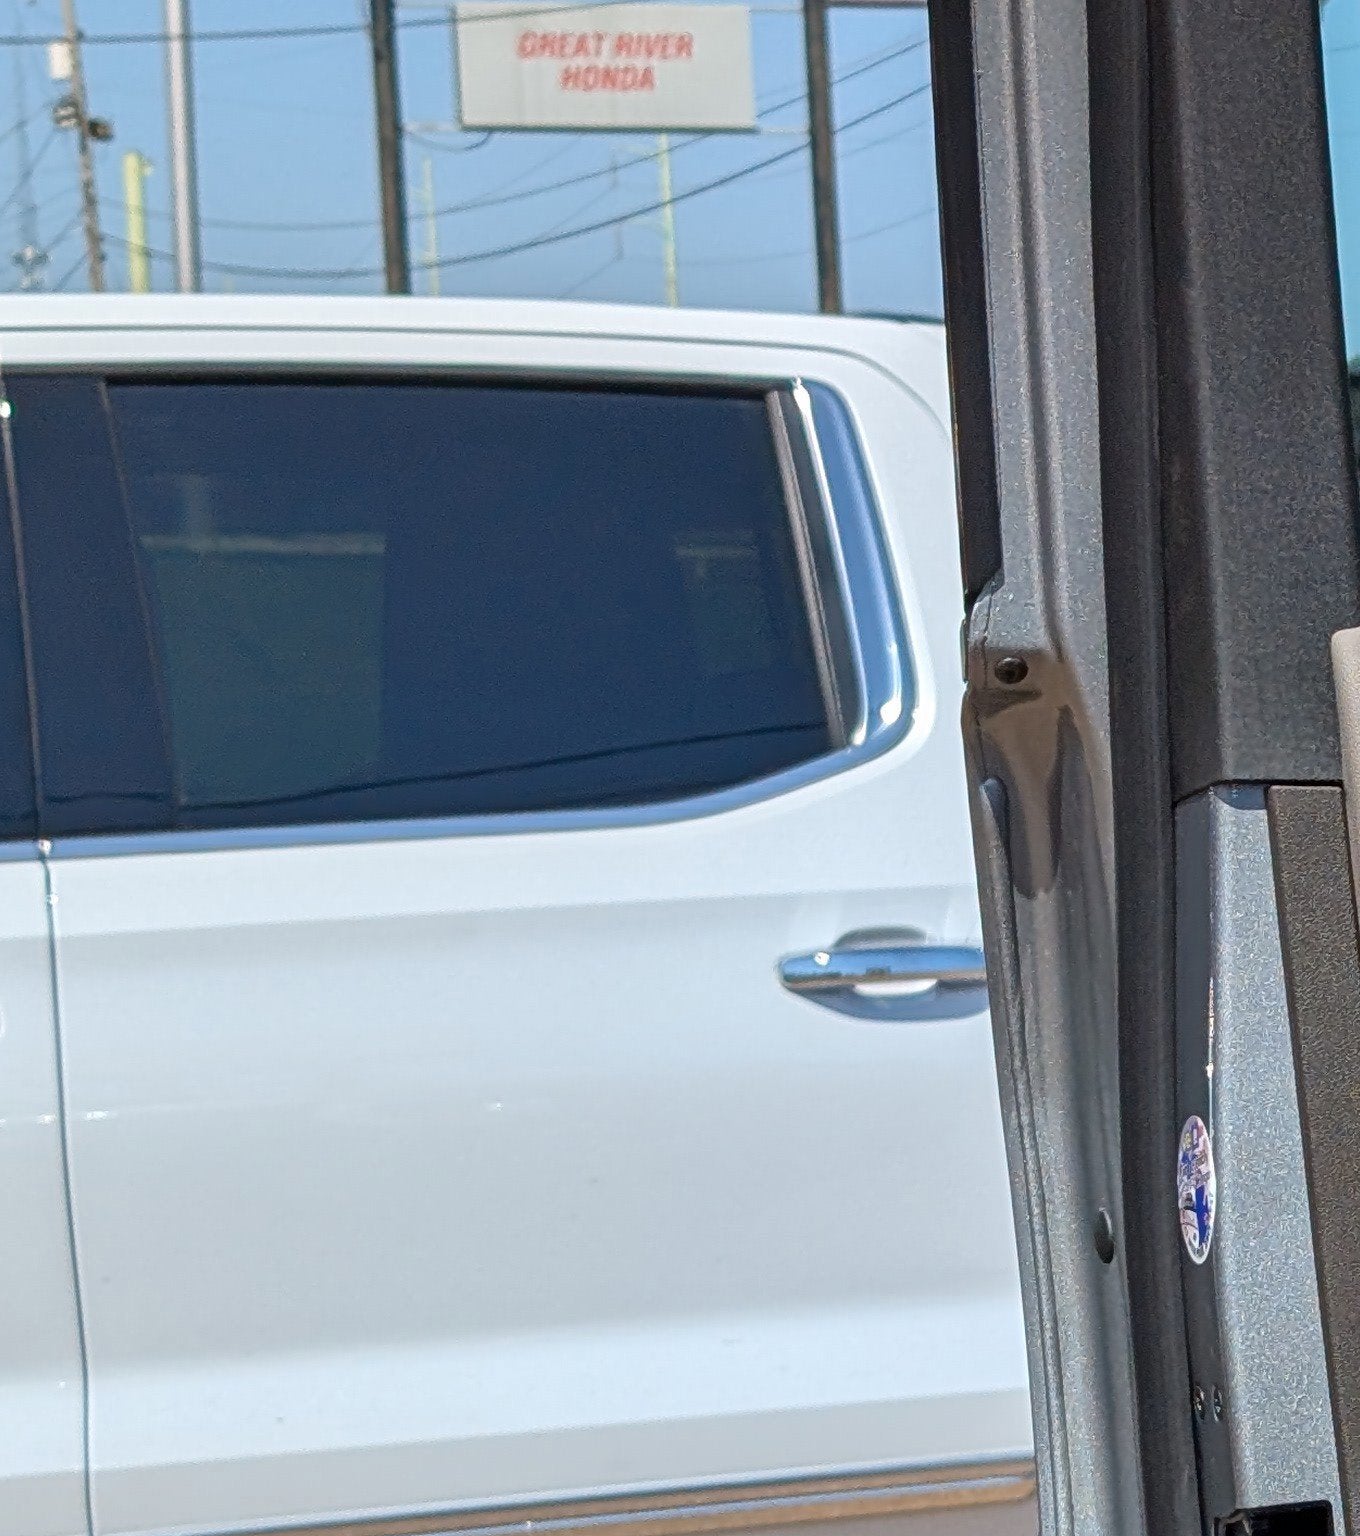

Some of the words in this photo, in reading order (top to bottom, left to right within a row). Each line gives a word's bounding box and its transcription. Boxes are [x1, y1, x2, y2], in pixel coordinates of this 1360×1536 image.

[516, 30, 606, 59] GREAT
[613, 31, 693, 60] RIVER
[559, 65, 655, 91] HONDA
